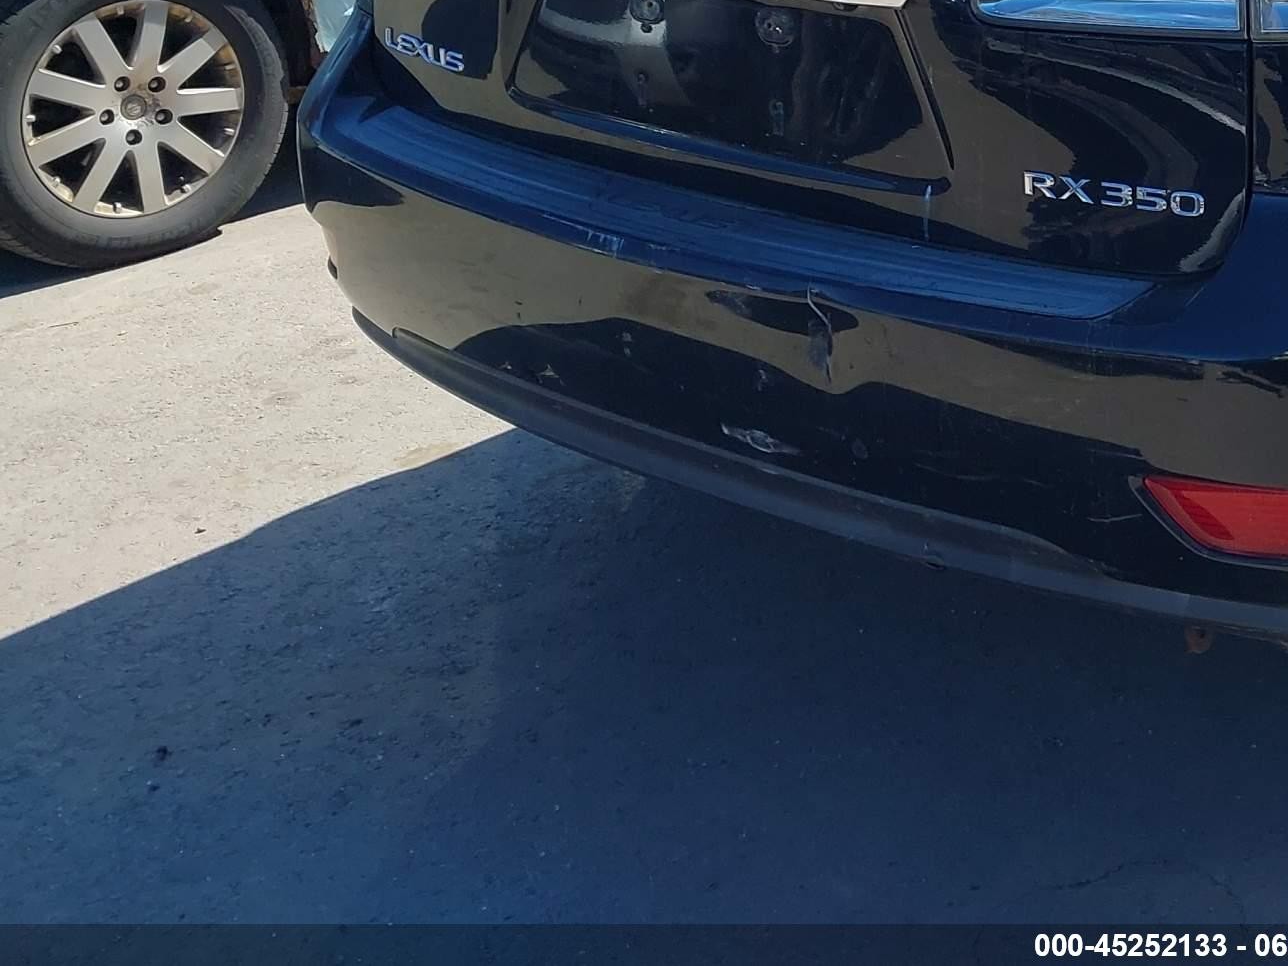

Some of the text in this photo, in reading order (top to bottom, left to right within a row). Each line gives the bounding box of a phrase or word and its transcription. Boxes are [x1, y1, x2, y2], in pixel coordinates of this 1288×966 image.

[384, 27, 465, 72] LEXUS
[1023, 171, 1205, 217] RX 350
